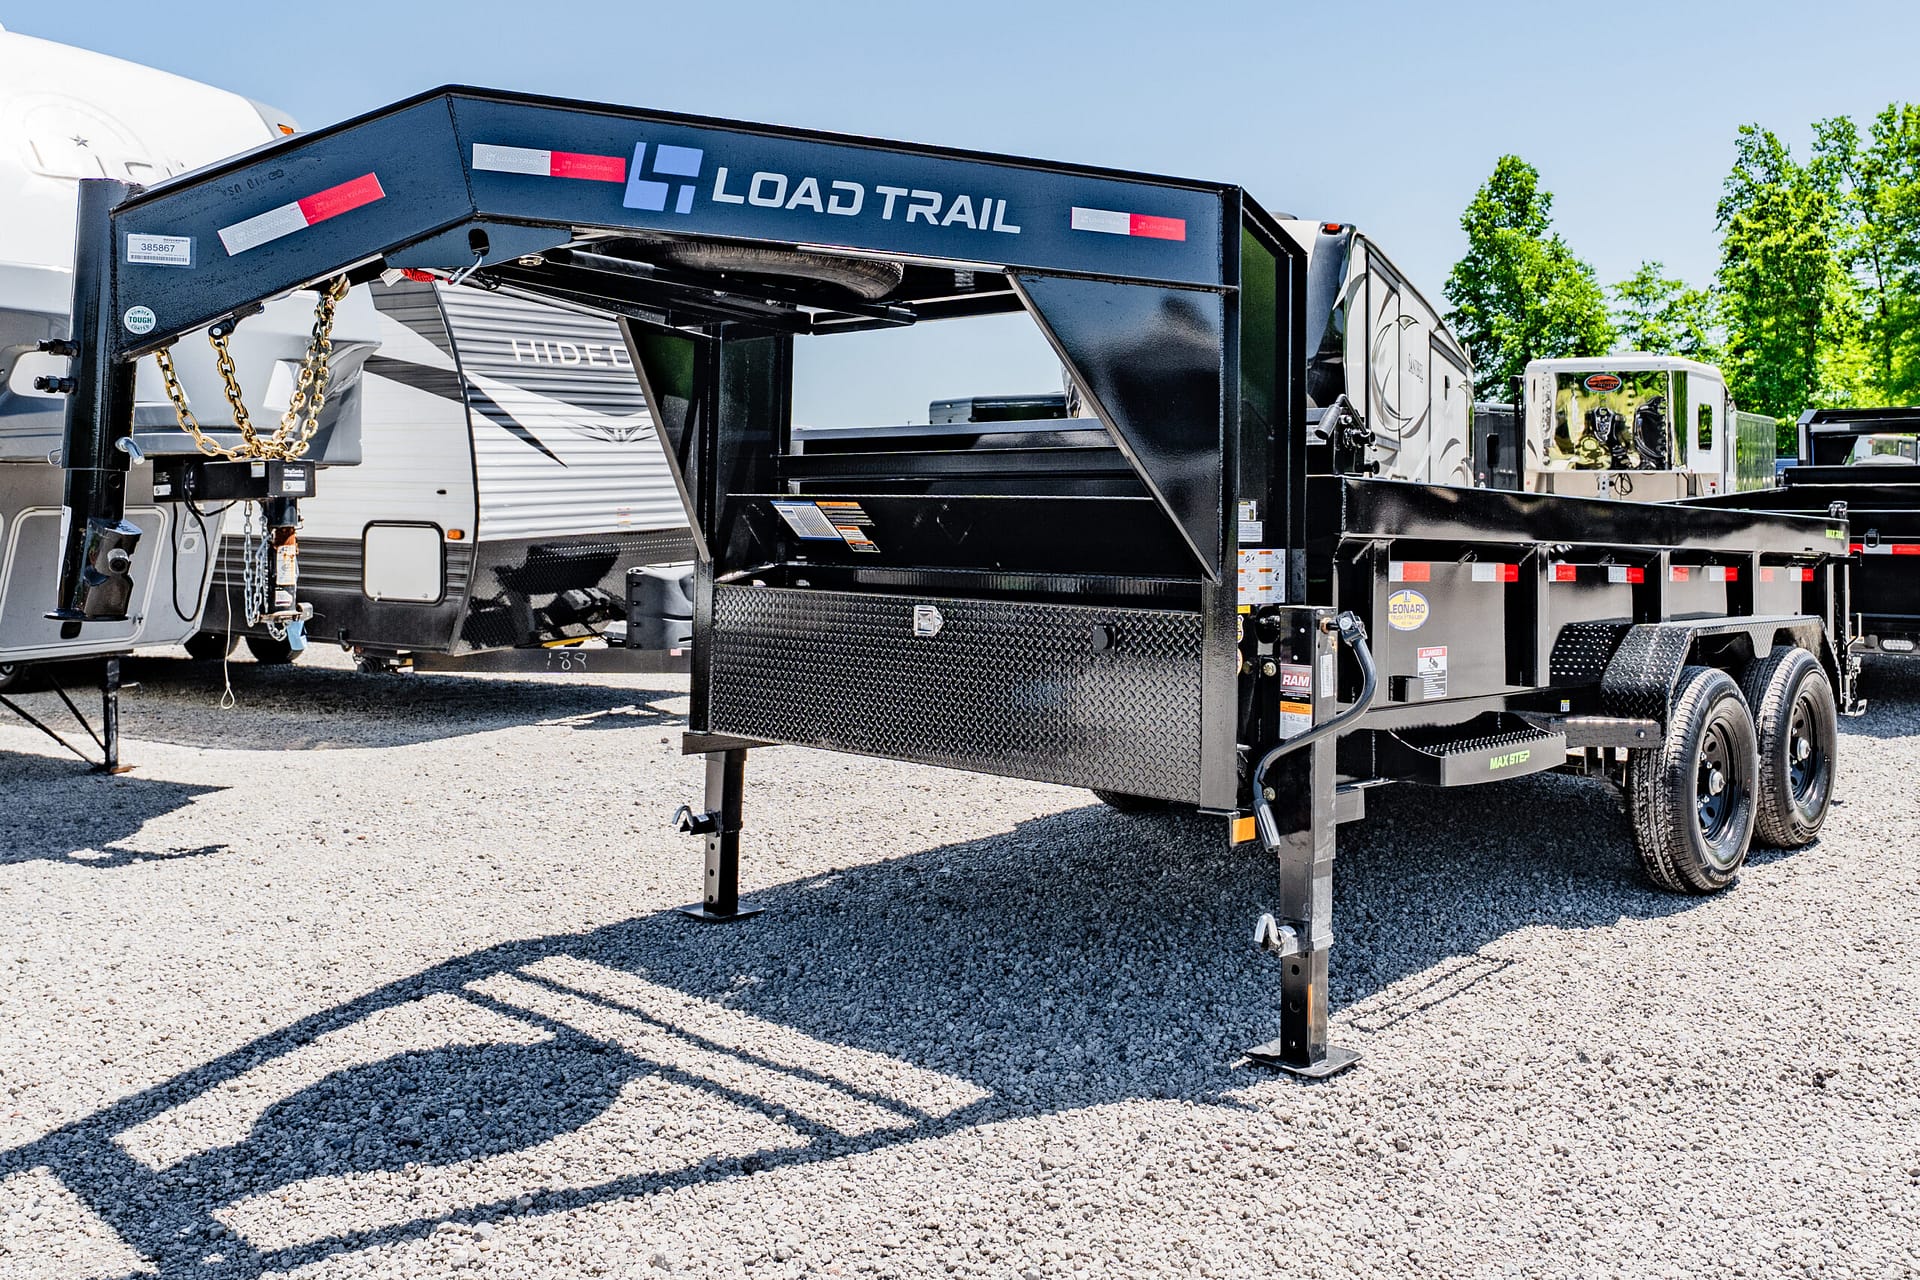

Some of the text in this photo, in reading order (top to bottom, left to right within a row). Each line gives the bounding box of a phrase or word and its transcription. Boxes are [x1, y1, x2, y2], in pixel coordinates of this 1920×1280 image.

[712, 167, 1021, 234] LOAD TRAIL
[141, 243, 175, 252] 385867
[129, 316, 152, 324] TOUGH
[1282, 674, 1310, 687] RAM
[1490, 749, 1530, 770] MAX STEP
